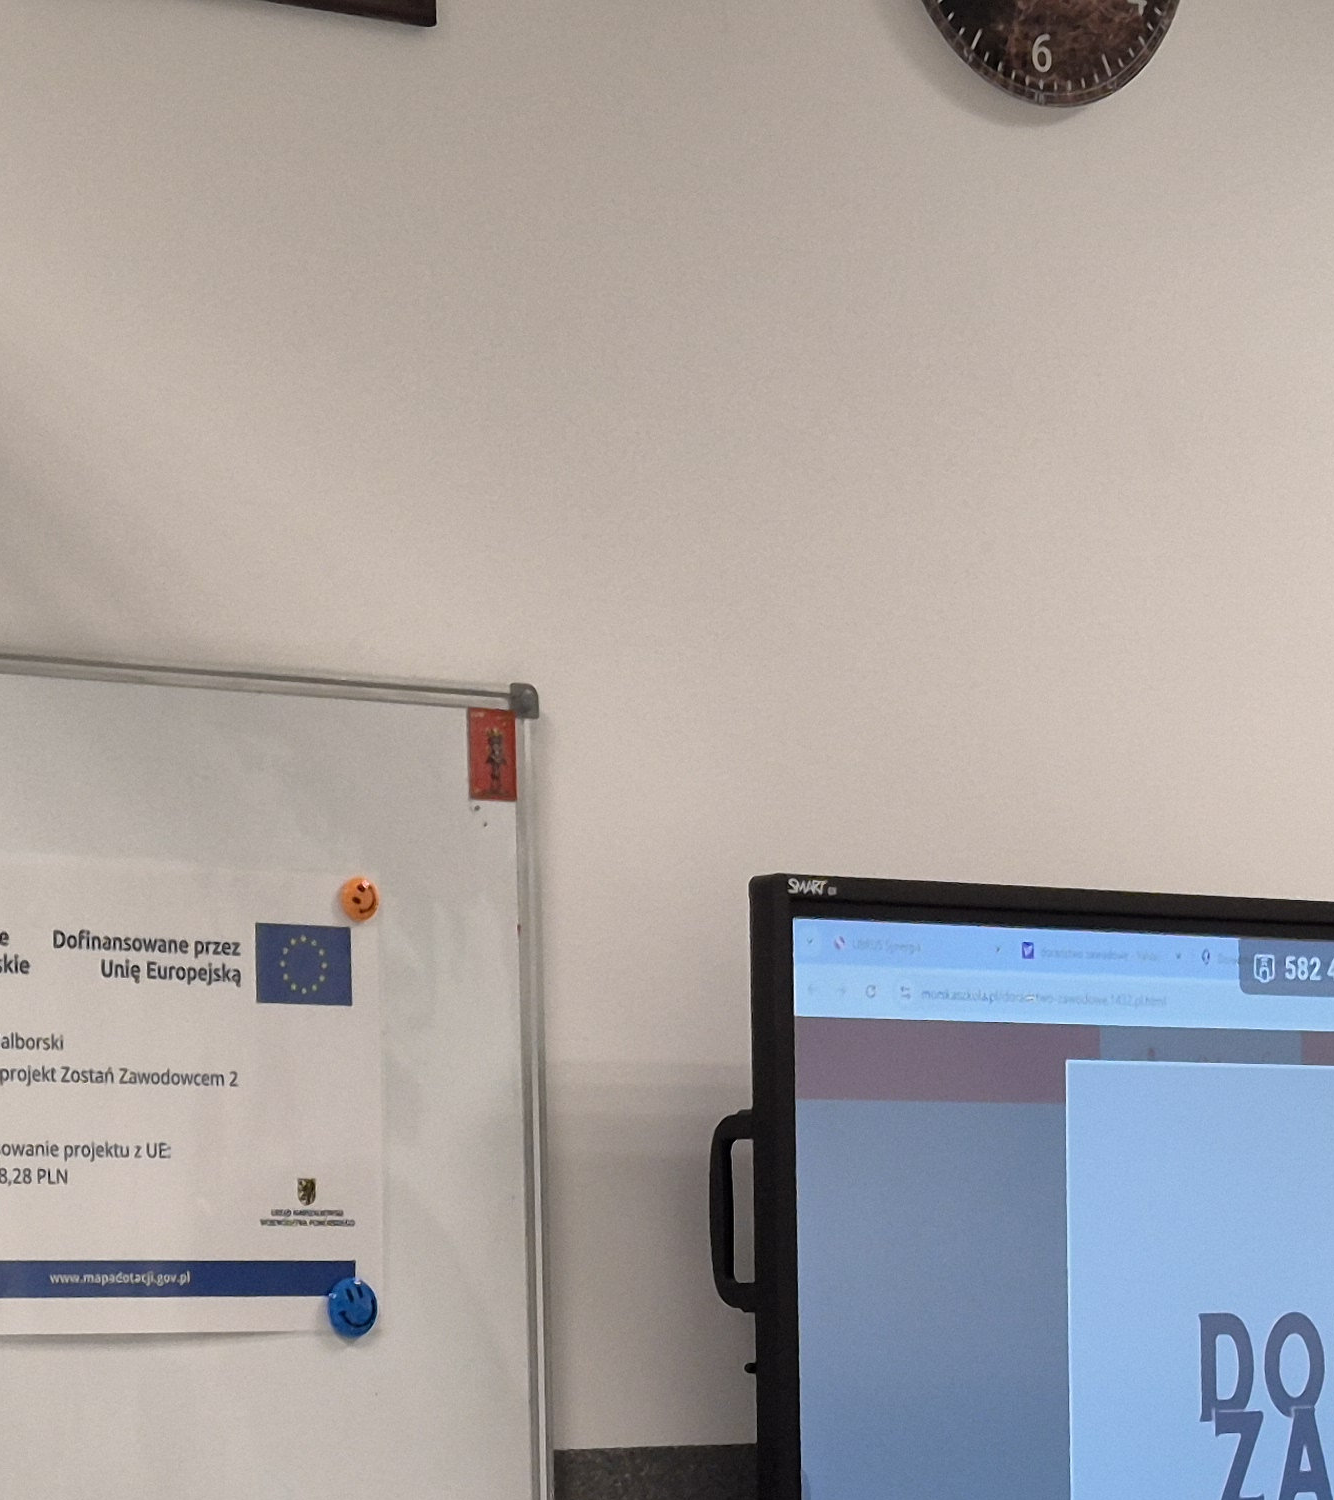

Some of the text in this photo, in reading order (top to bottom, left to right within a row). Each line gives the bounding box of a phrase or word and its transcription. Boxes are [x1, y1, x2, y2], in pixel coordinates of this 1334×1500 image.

[1031, 33, 1053, 73] 6
[787, 878, 827, 896] SMART
[52, 929, 241, 959] Dofinansowane przez
[100, 959, 242, 987] Unię Europejską
[1285, 956, 1322, 981] 582
[0, 1063, 56, 1087] projekt
[60, 1066, 114, 1084] Zostań
[119, 1068, 224, 1087] Zawodowcem
[228, 1071, 238, 1087] 2
[64, 1140, 129, 1162] projektu
[134, 1145, 142, 1158] z
[146, 1142, 171, 1159] UE:
[37, 1168, 68, 1185] PLN
